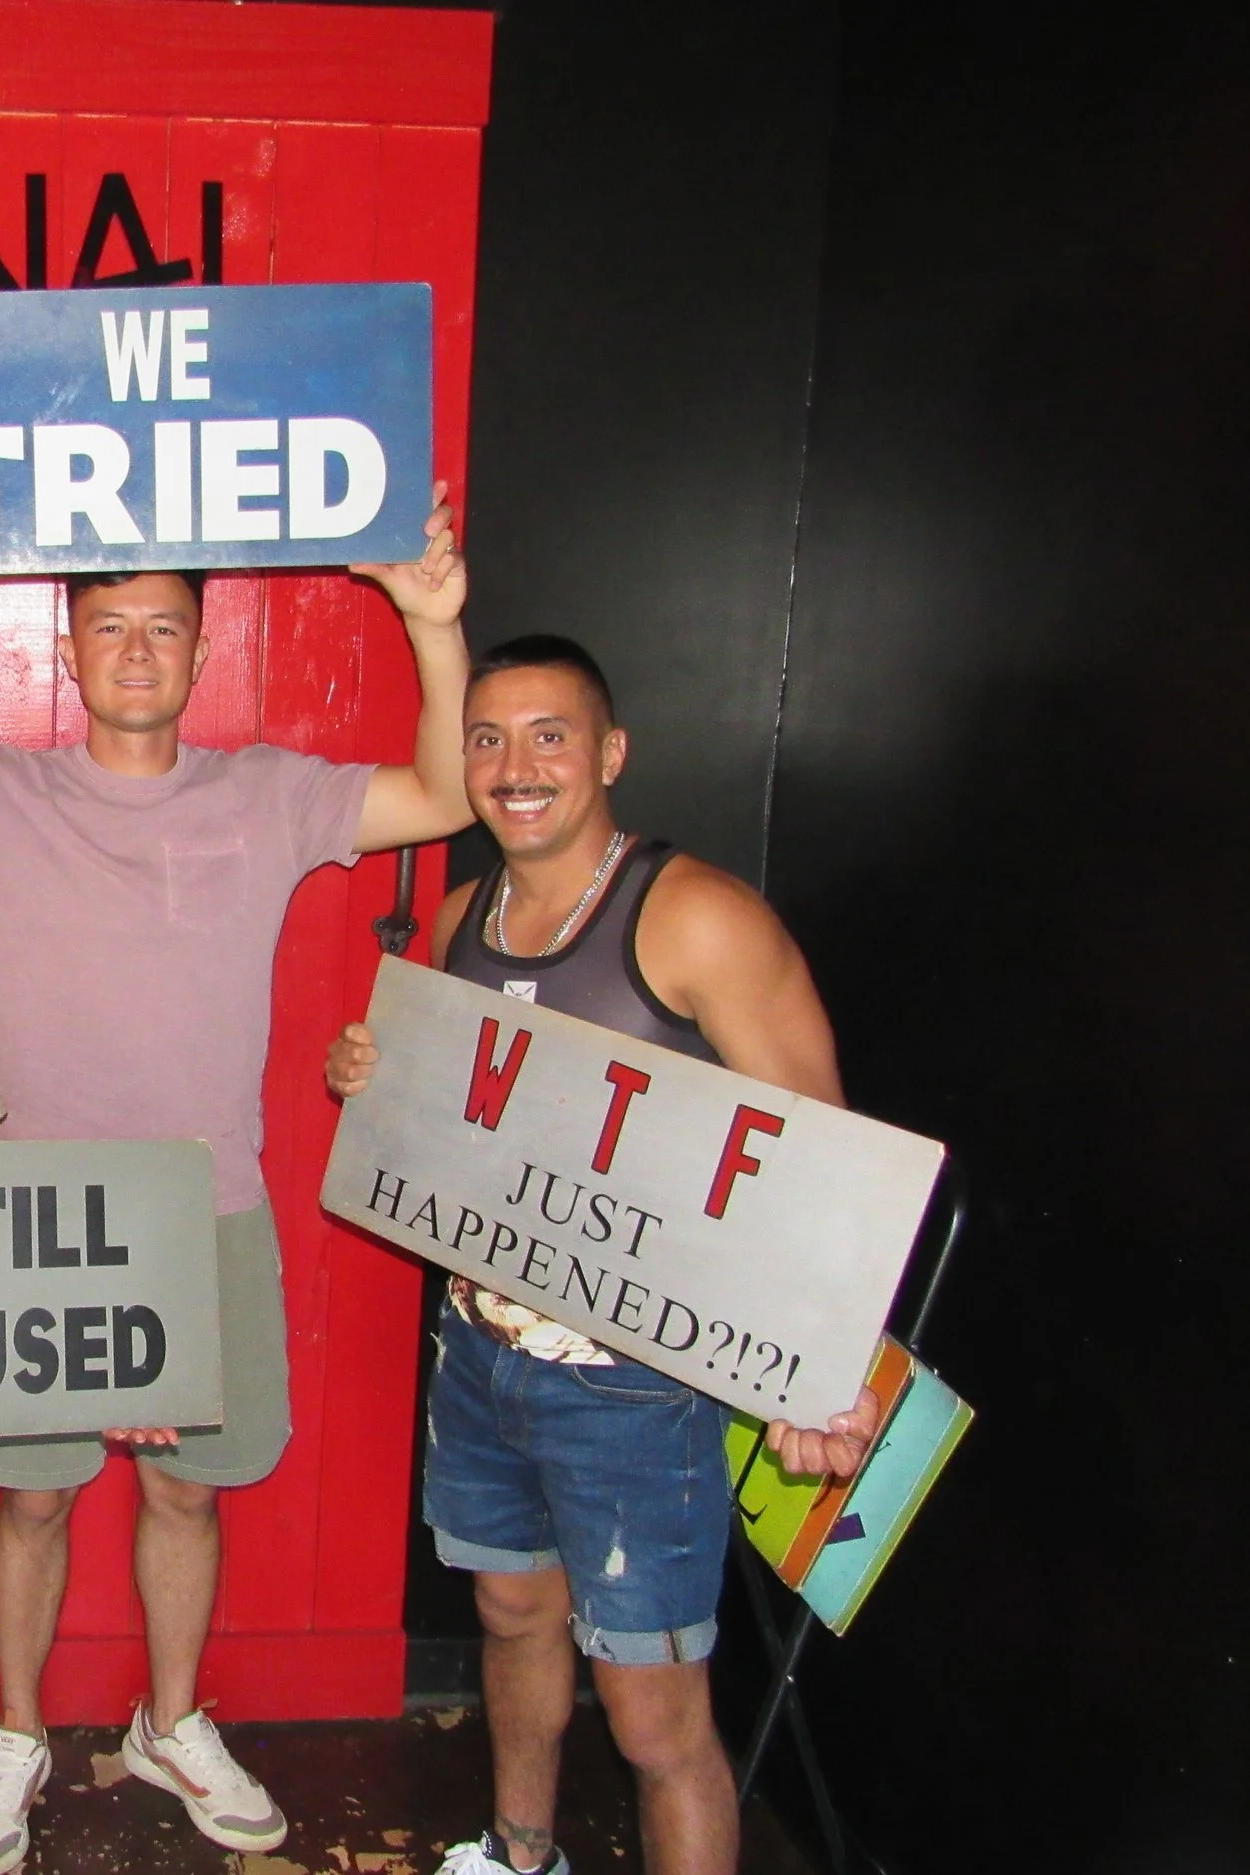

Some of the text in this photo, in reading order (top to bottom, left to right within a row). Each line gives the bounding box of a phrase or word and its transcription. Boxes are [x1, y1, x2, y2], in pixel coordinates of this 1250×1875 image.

[101, 309, 210, 401] WE
[506, 1162, 663, 1260] JUST
[364, 1168, 802, 1403] HAPPENED?!?!
